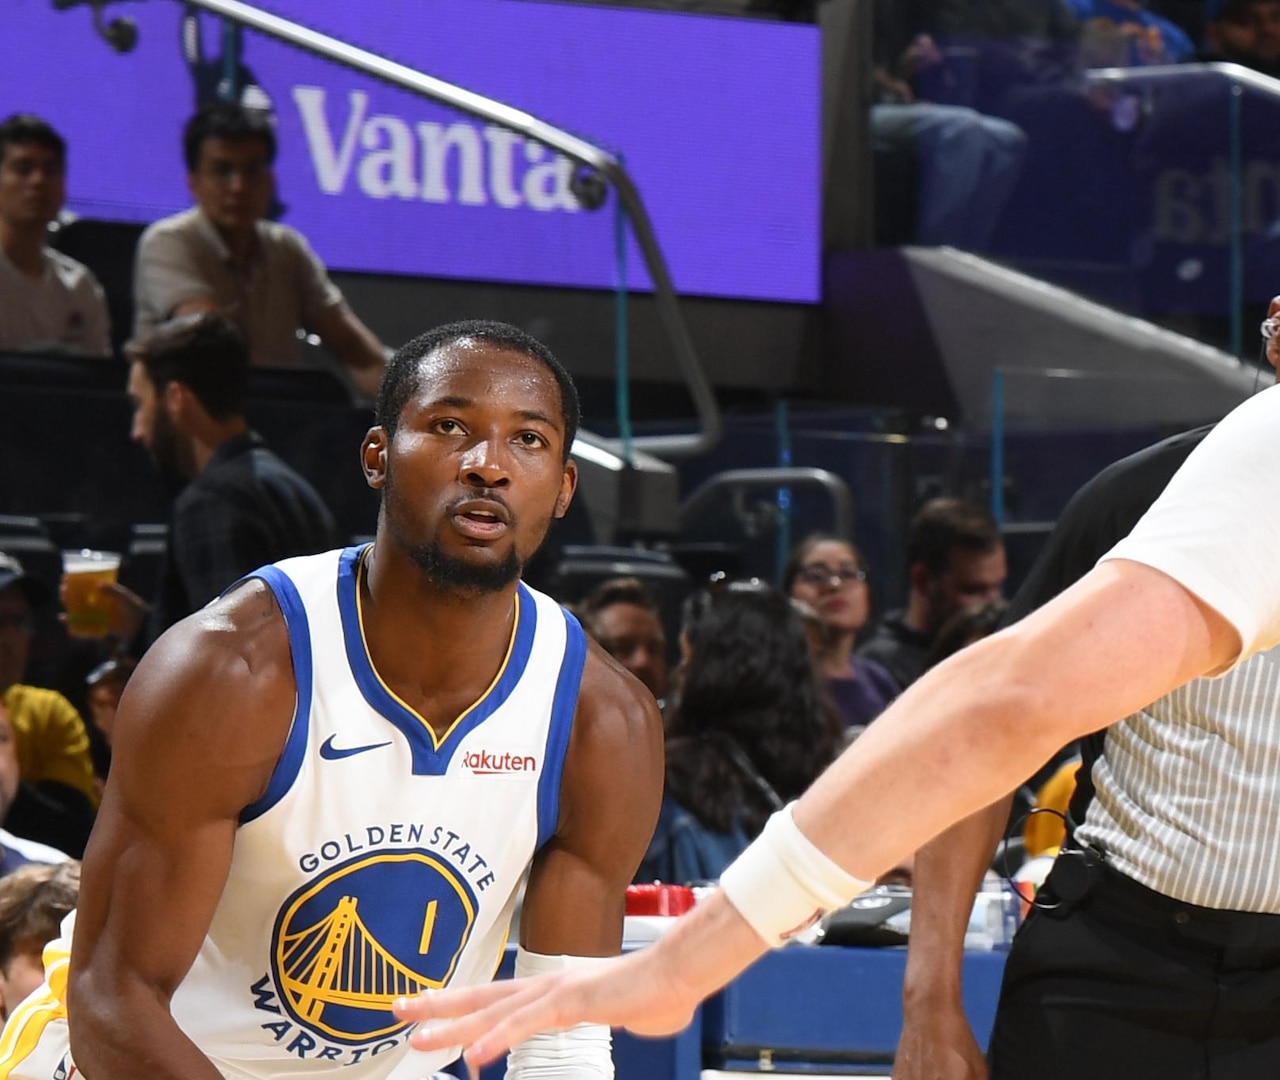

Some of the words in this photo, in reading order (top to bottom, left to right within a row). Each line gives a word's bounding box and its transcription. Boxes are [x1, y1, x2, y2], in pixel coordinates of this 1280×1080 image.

[292, 85, 580, 212] Vanta
[299, 823, 424, 873] GOLDEN
[430, 826, 496, 891] STATE
[419, 899, 438, 955] 1
[250, 972, 418, 1066] WARRIO
